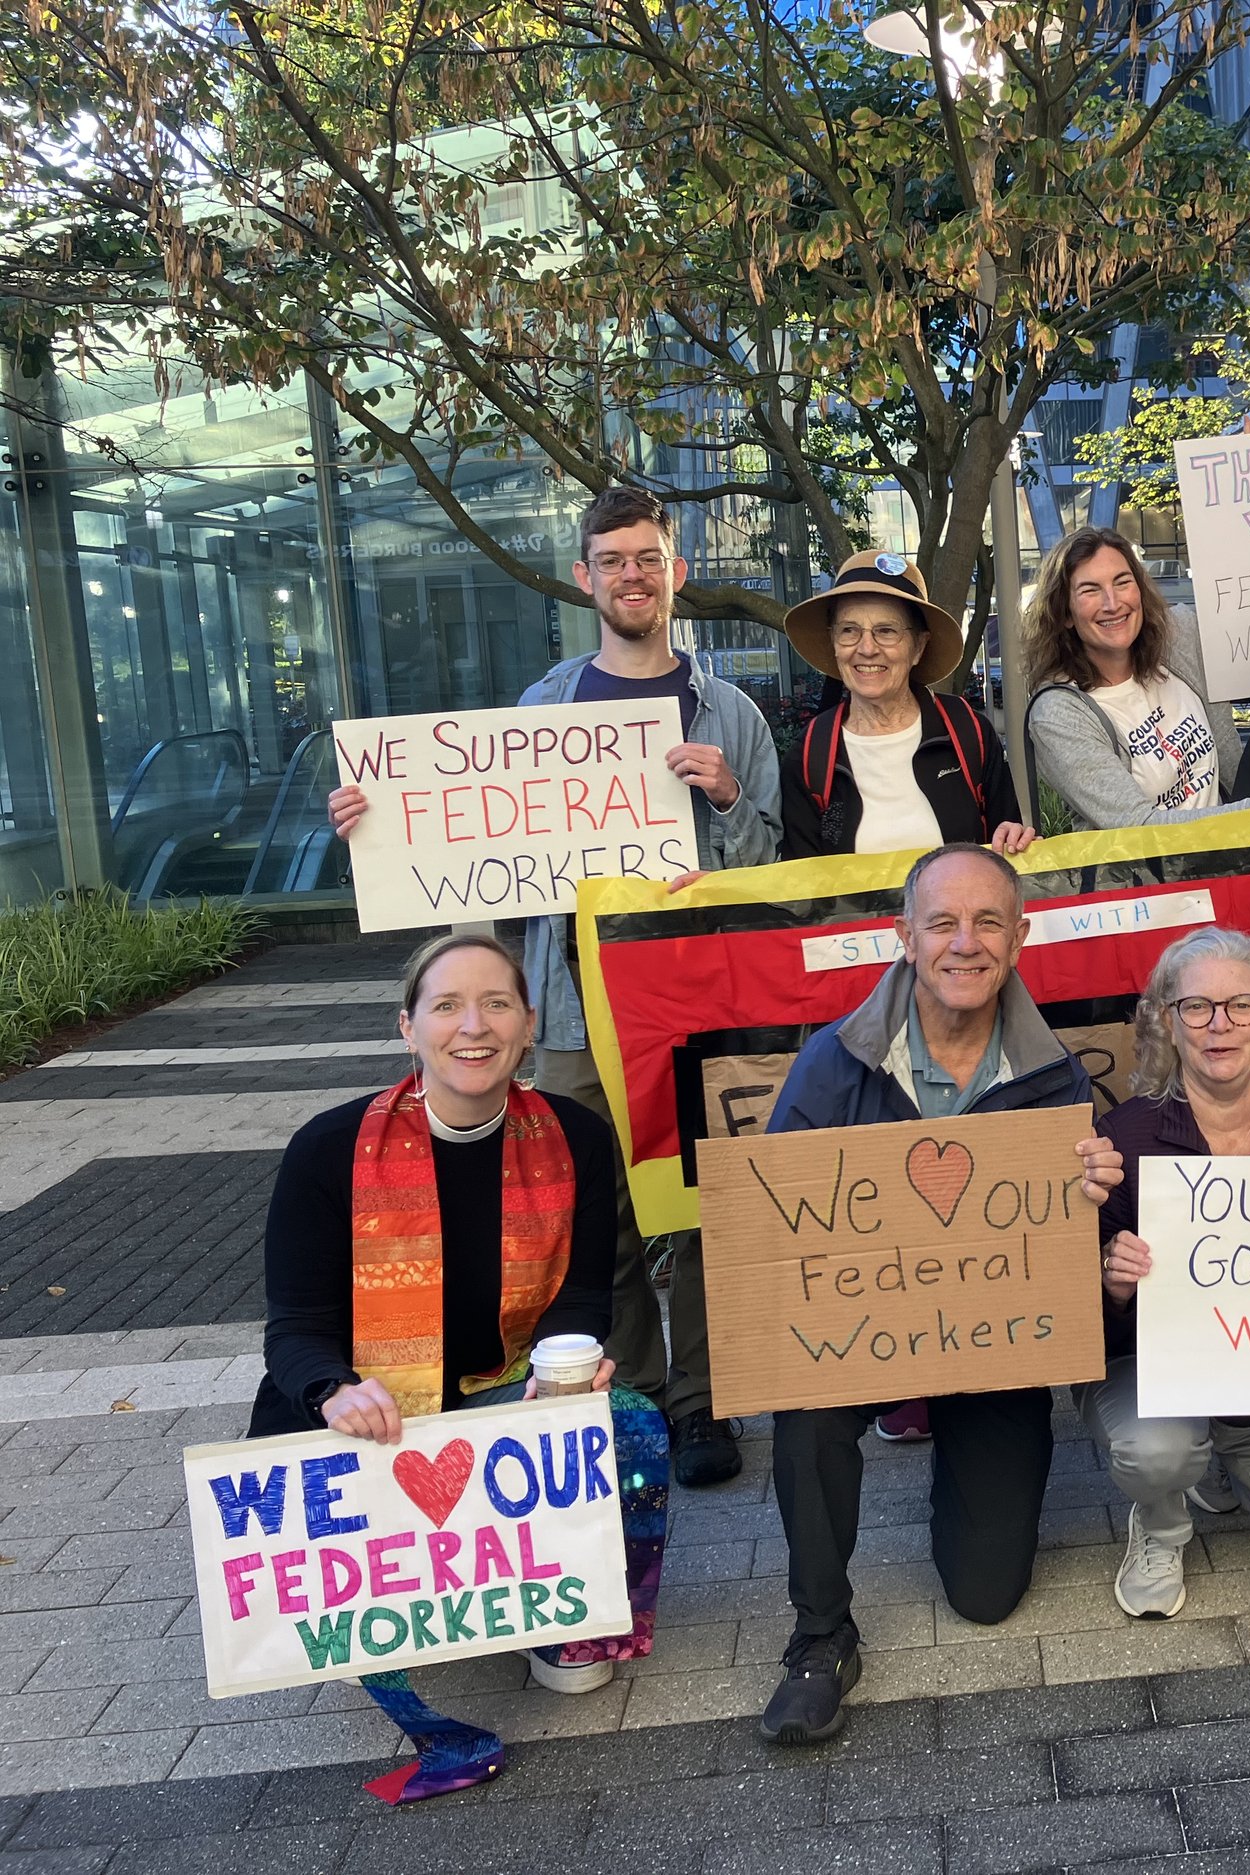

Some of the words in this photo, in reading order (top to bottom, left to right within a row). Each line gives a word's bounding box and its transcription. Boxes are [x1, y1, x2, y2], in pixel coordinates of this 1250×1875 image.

[337, 731, 407, 784] WE
[433, 719, 660, 776] SUPPORT
[1171, 724, 1207, 762] RIGHTS
[401, 772, 678, 845] FEDERAL
[1164, 767, 1215, 811] EQUALITY
[1070, 901, 1151, 932] WITH
[748, 1148, 882, 1234] We
[984, 1174, 1083, 1230] our
[800, 1233, 1031, 1301] Federal
[789, 1309, 1054, 1362] Workers
[208, 1452, 369, 1540] WE
[483, 1426, 613, 1519] OUR
[223, 1521, 563, 1621] FEDERAL
[294, 1575, 589, 1670] WORKERS
